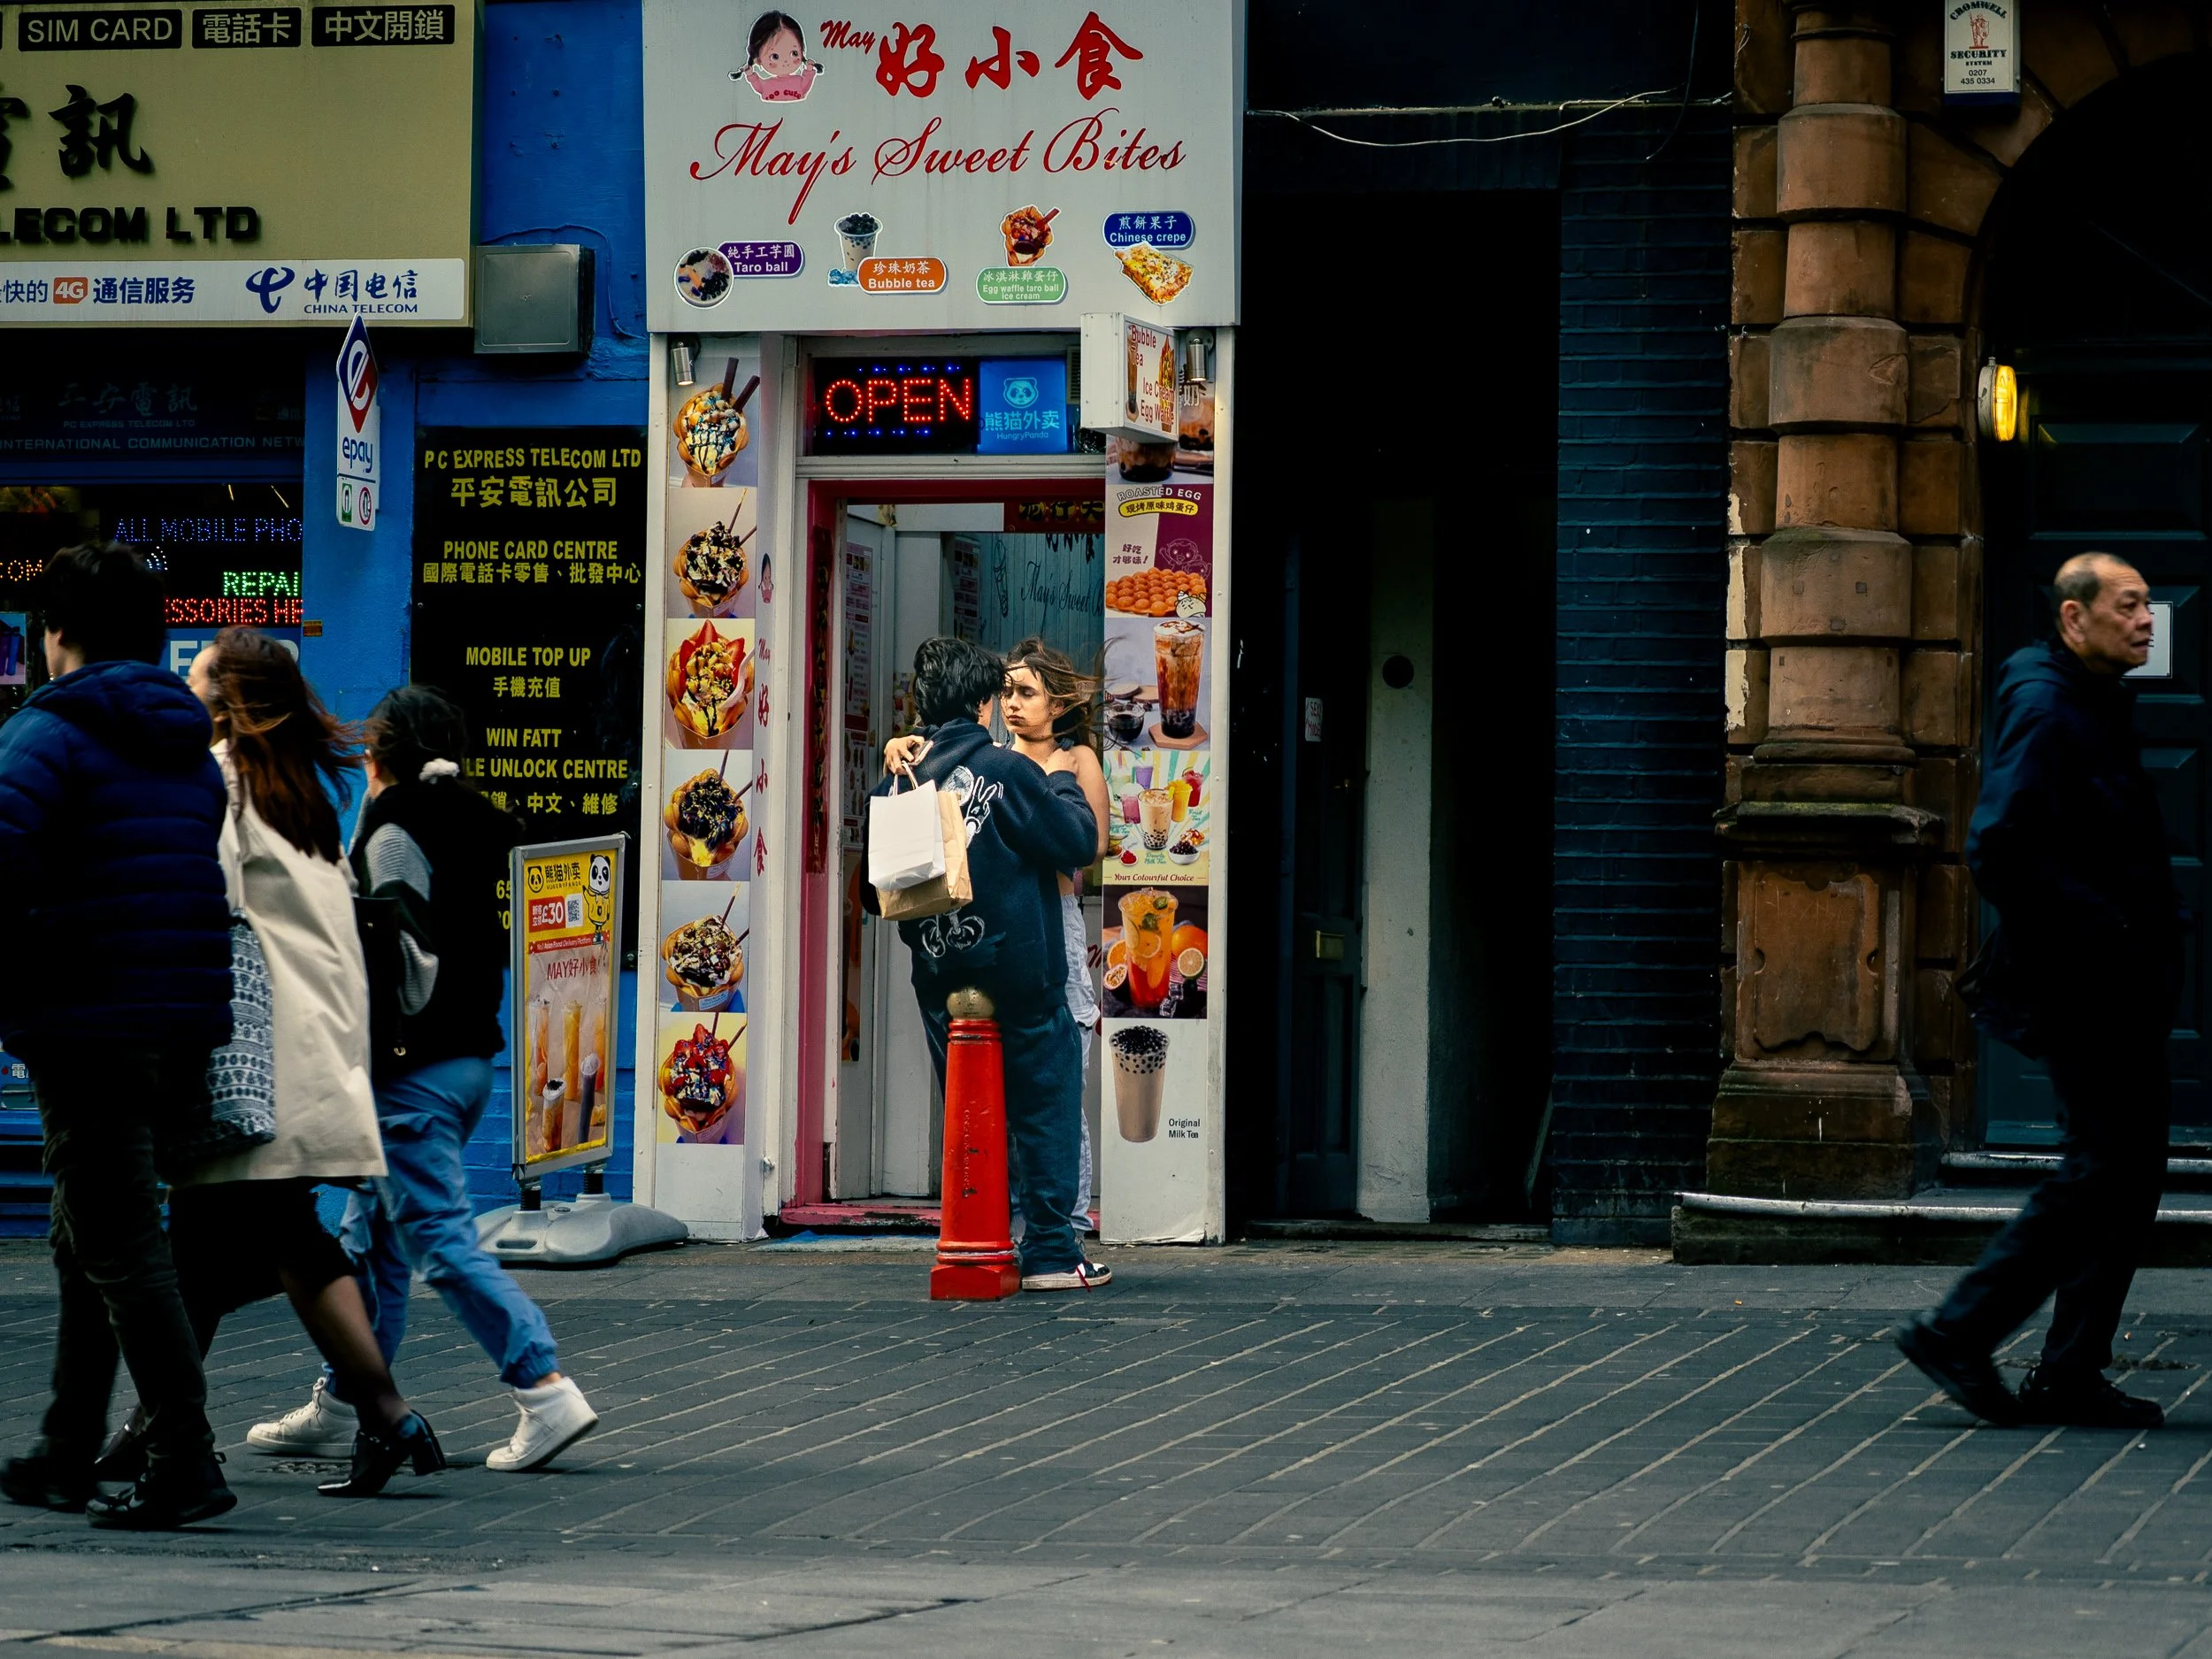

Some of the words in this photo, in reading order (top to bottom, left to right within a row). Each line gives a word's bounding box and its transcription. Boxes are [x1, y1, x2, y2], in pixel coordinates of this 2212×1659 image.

[1949, 1, 2008, 20] CROMWELL
[27, 19, 79, 43] SIM
[89, 17, 173, 42] CARD
[203, 13, 293, 44] 電話卡
[324, 10, 445, 42] 中文開鎖
[819, 19, 876, 52] May
[875, 11, 1144, 101] 好小食
[1950, 50, 2008, 59] SECURITY
[764, 90, 780, 101] oo
[783, 89, 802, 99] cute
[0, 84, 156, 189] 訊
[689, 117, 856, 226] May's
[871, 117, 1036, 186] Sweet
[1042, 107, 1187, 174] Bites
[165, 205, 258, 241] LTD
[1118, 215, 1178, 231] 煎餅果子
[1109, 232, 1154, 243] Chinese
[1156, 234, 1187, 244] crepe
[726, 243, 795, 260] 純手工芋圓
[733, 262, 763, 273] Taro
[765, 260, 788, 273] ball
[872, 260, 932, 275] 珍珠奶茶
[983, 270, 1059, 283] 冰淇淋雞蛋仔
[0, 278, 48, 304] 快的
[55, 280, 85, 300] 4G
[92, 275, 196, 305] 通信服务
[303, 268, 419, 303] 中国电信
[868, 277, 913, 290] Bubble
[916, 278, 935, 289] tea
[982, 284, 999, 295] Egg
[1001, 283, 1025, 293] waffle
[1025, 283, 1043, 292] taro
[1043, 282, 1059, 292] ball
[303, 303, 349, 315] CHINA
[353, 303, 419, 314] TELECOM
[1131, 324, 1156, 349] Bubble
[1132, 352, 1144, 367] ea
[824, 378, 972, 424] OPEN
[1142, 377, 1153, 396] Ice
[1154, 380, 1175, 403] Cream
[984, 410, 1060, 432] 熊猫外卖
[1141, 399, 1153, 424] Egg
[1155, 403, 1175, 426] Waffle
[63, 419, 77, 429] PC
[79, 419, 125, 429] EXPRESS
[128, 419, 173, 429] TELECOM
[0, 438, 121, 450] INTERNATIONAL
[127, 437, 256, 449] COMMUNICATION
[996, 431, 1049, 442] HungryPanda
[342, 436, 373, 473] epay
[453, 447, 526, 470] EXPRESS
[530, 447, 607, 469] TELECOM
[611, 448, 642, 469] LTD
[450, 474, 618, 509] 平安電訊公司
[1117, 487, 1173, 502] ROASTED
[1177, 488, 1202, 501] EGG
[1125, 499, 1195, 515] 现烤原味鸡蛋仔
[113, 517, 153, 542] ALL
[159, 517, 248, 542] MOBILE
[443, 539, 500, 560] PHONE
[503, 539, 549, 560] CARD
[552, 539, 618, 560] CENTRE
[1122, 543, 1142, 555] 好吃
[0, 558, 43, 582] OM
[422, 562, 642, 585] 國際電話卡零售、批發中心
[1058, 569, 1091, 614] Sweet
[465, 646, 527, 667] MOBILE
[531, 646, 565, 667] TOP
[569, 646, 592, 667] UP
[757, 637, 772, 665] May
[492, 675, 562, 699] 手機充值
[486, 727, 518, 749] WIN
[522, 727, 563, 749] FATT
[489, 757, 557, 779] UNLOCK
[562, 758, 628, 780] CENTRE
[753, 682, 770, 877] 好小食
[544, 862, 582, 884] 熊猫外卖
[1114, 873, 1131, 882] Your
[1133, 873, 1169, 882] Colourful
[541, 901, 565, 926] £30
[12, 1063, 29, 1079] 電
[1168, 1118, 1201, 1129] Original
[1168, 1129, 1186, 1139] Milk
[1186, 1129, 1200, 1139] Tea
